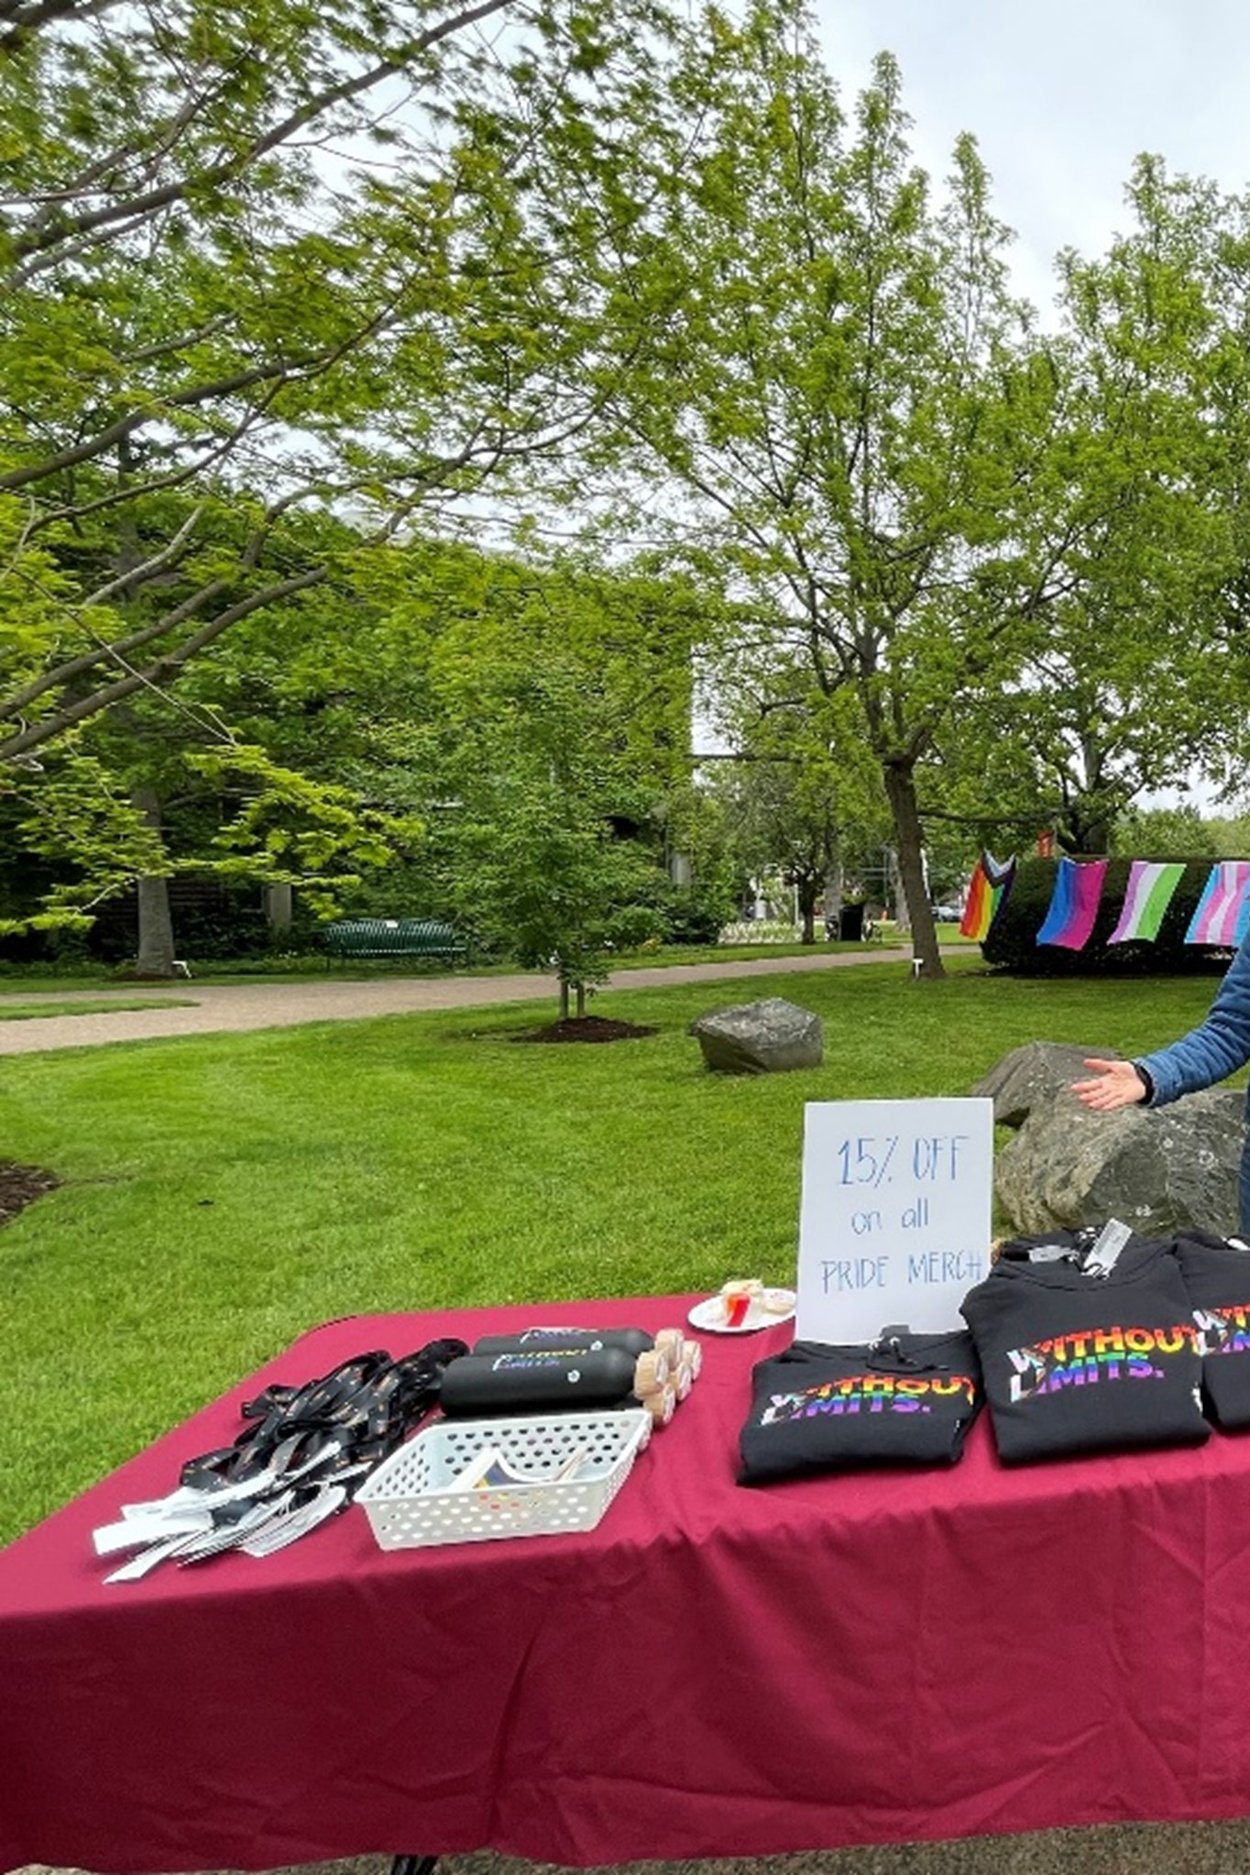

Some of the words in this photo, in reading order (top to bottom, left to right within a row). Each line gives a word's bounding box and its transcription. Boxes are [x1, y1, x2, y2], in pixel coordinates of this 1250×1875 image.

[837, 1135, 899, 1189] 15%
[912, 1135, 969, 1181] OFF
[851, 1208, 882, 1235] on
[901, 1198, 929, 1229] all
[820, 1255, 889, 1294] PRIDE
[907, 1249, 982, 1284] MERCH
